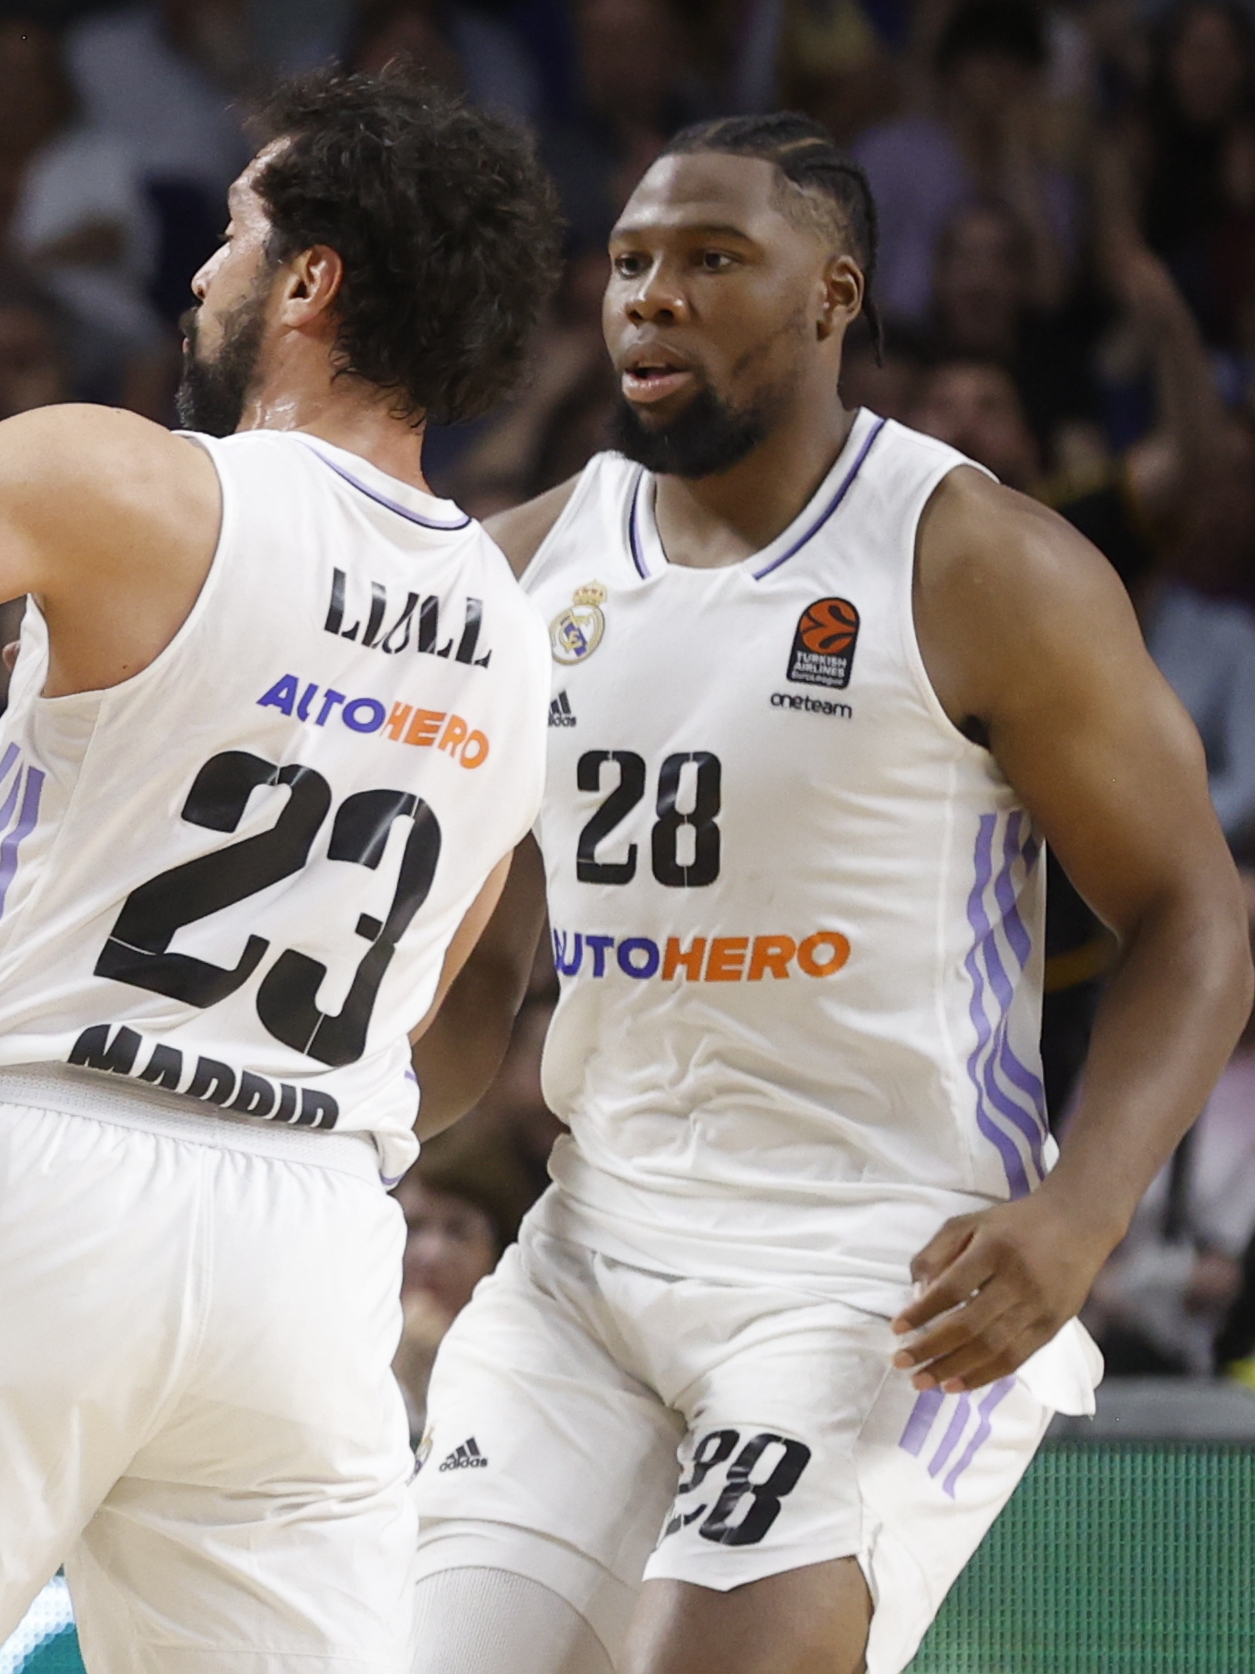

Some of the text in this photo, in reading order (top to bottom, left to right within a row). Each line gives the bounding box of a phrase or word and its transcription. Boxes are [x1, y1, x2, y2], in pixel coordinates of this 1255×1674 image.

[793, 661, 846, 678] AIRLINES
[796, 650, 848, 669] TURKISH
[770, 693, 853, 719] oneteam
[576, 749, 722, 888] 28
[94, 750, 442, 1067] 23
[553, 928, 851, 982] UTOHERO
[439, 1455, 488, 1472] adidas
